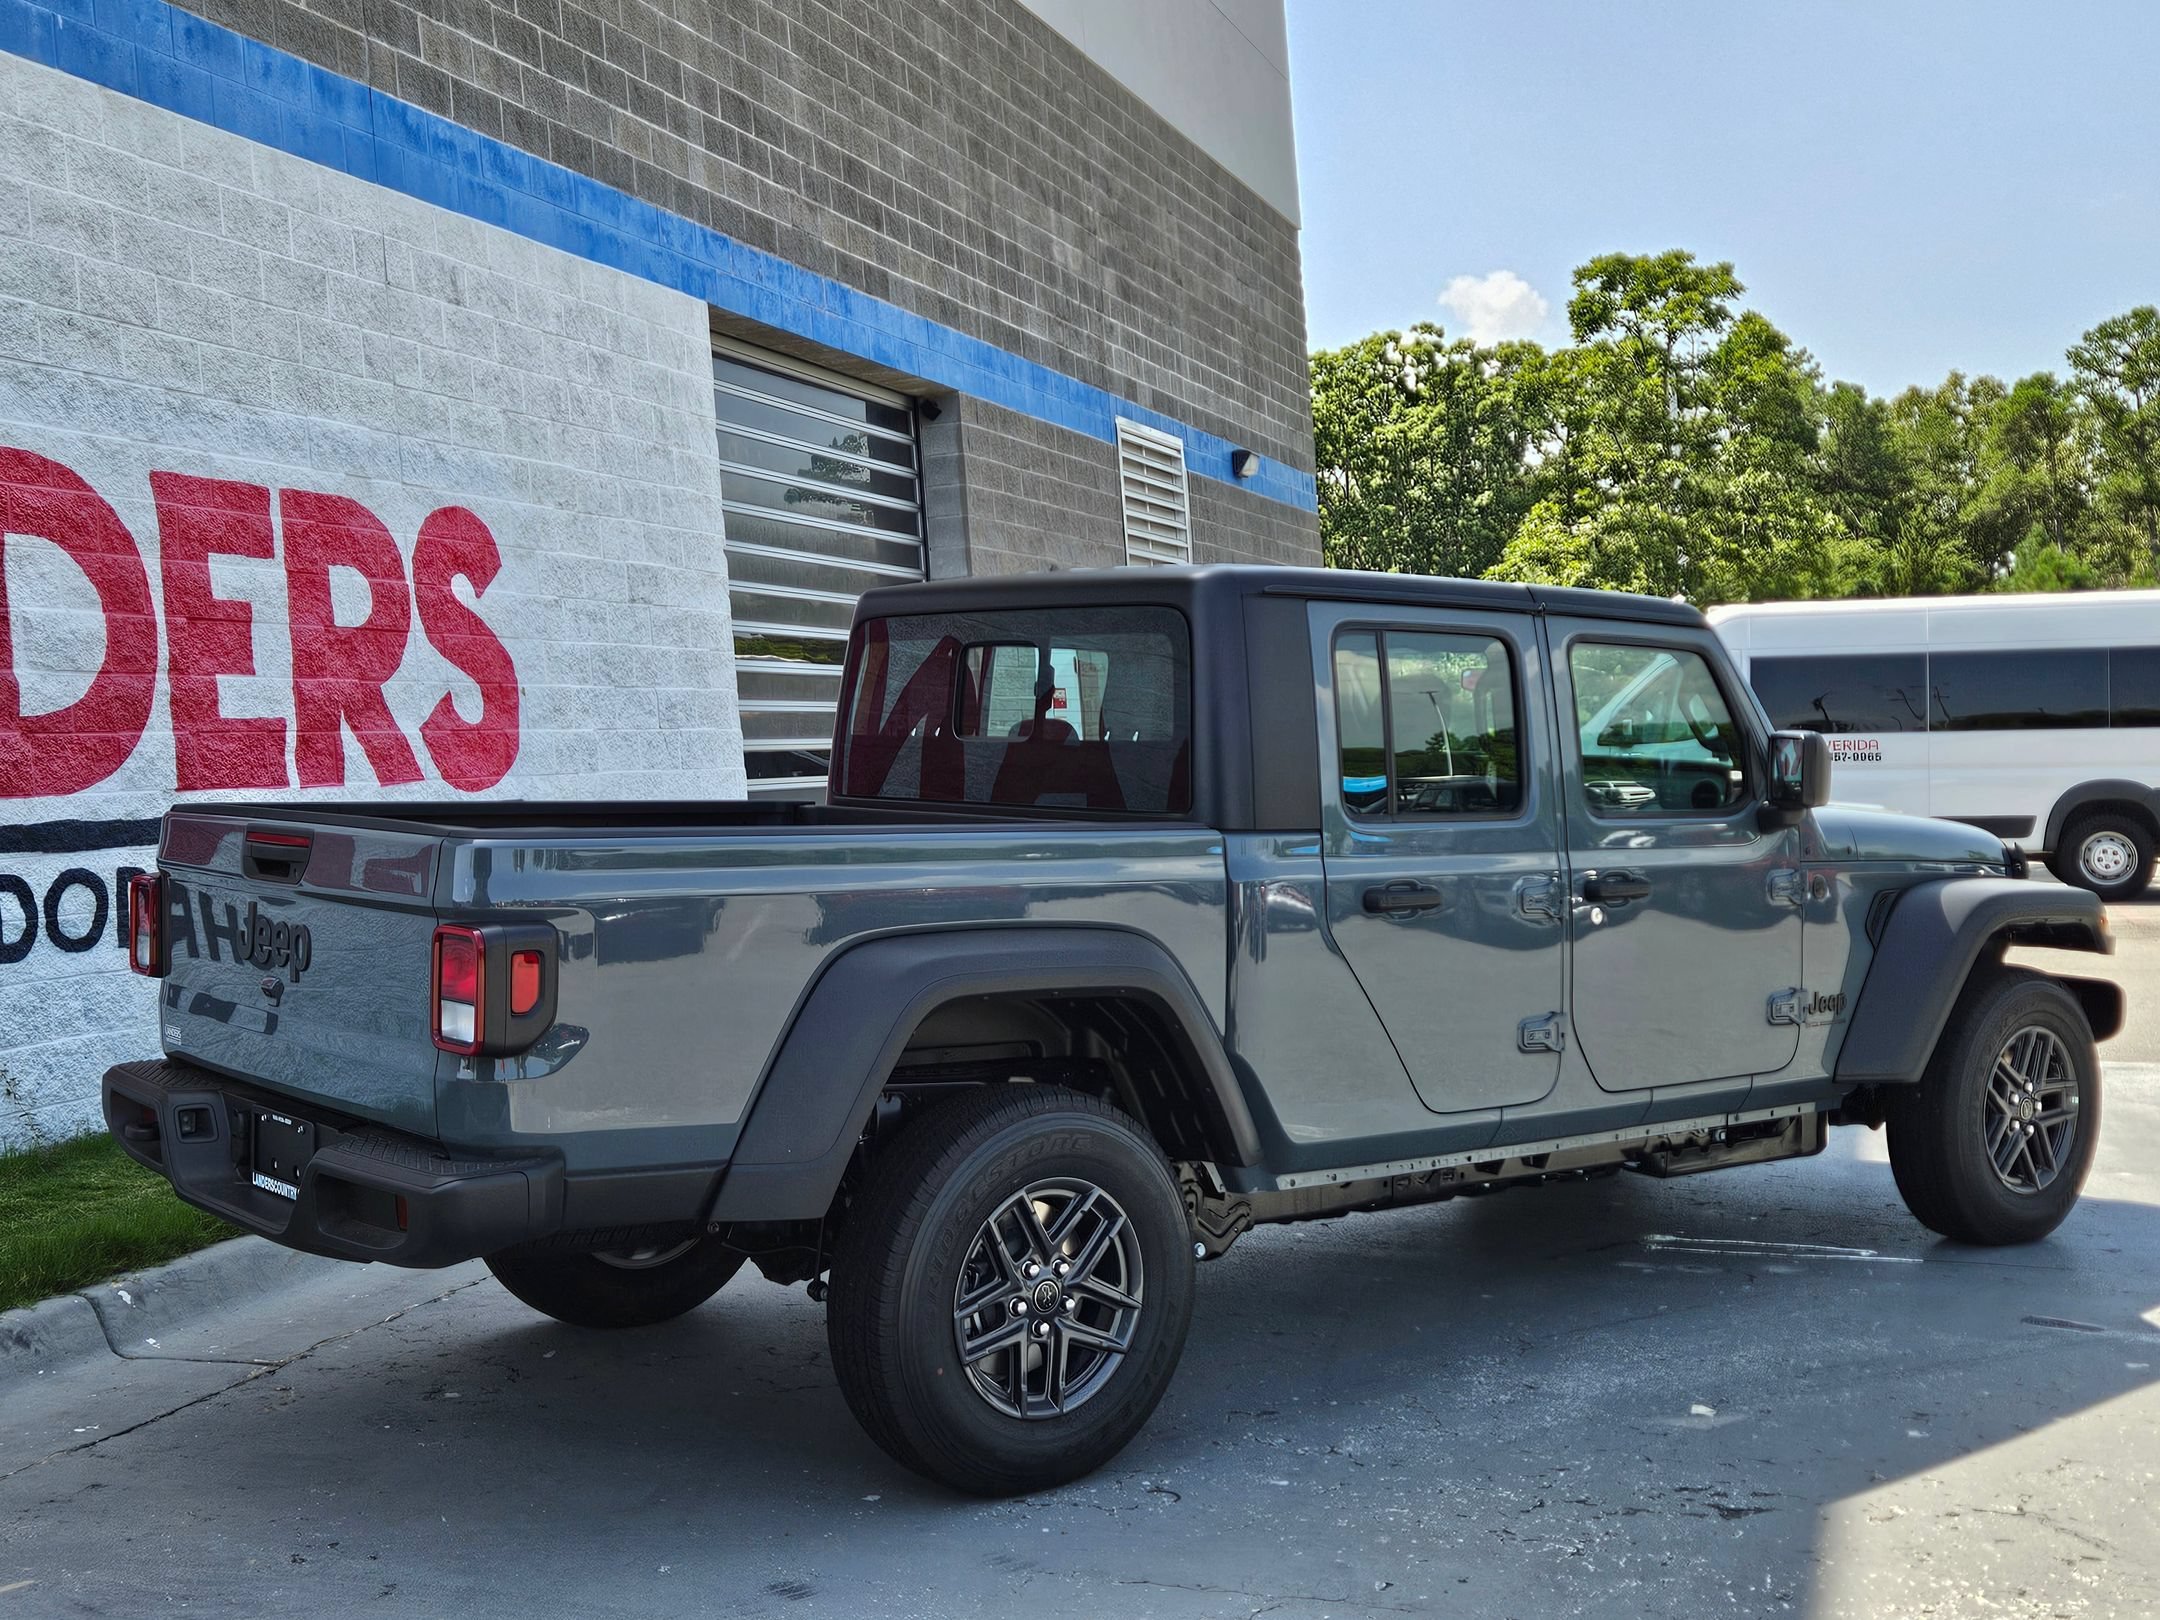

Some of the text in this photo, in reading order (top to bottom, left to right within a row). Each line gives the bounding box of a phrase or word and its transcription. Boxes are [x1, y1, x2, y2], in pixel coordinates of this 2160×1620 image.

[0, 446, 520, 800] DERS
[236, 901, 312, 983] Jeep
[1808, 991, 1847, 1016] Jeep
